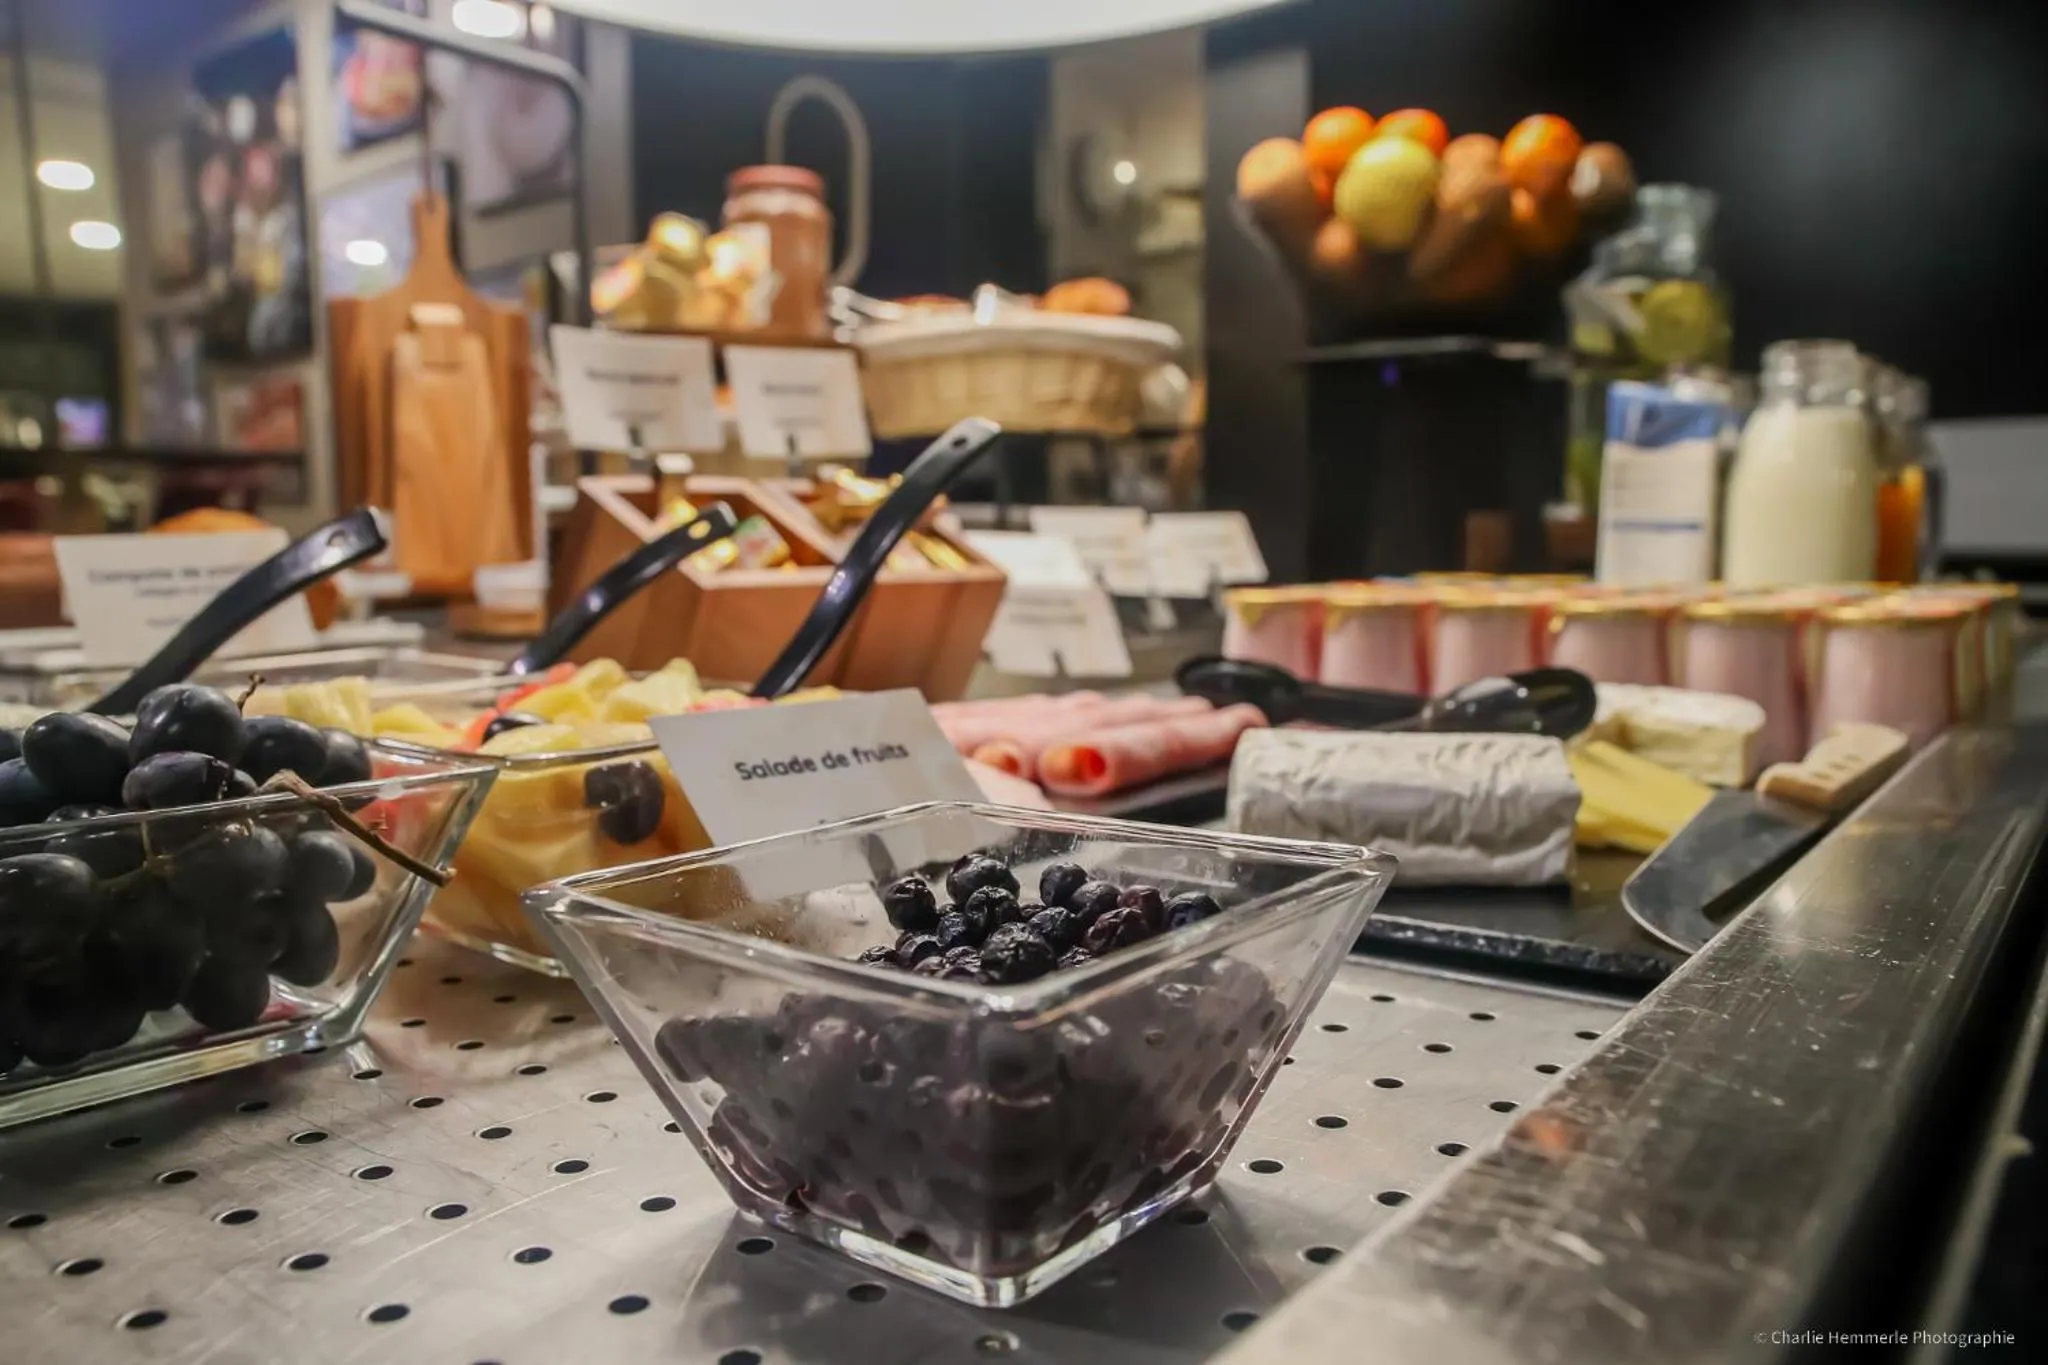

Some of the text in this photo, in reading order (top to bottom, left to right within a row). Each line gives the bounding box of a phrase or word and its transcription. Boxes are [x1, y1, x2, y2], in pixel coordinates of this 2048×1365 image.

[735, 743, 909, 781] Salade de fruits
